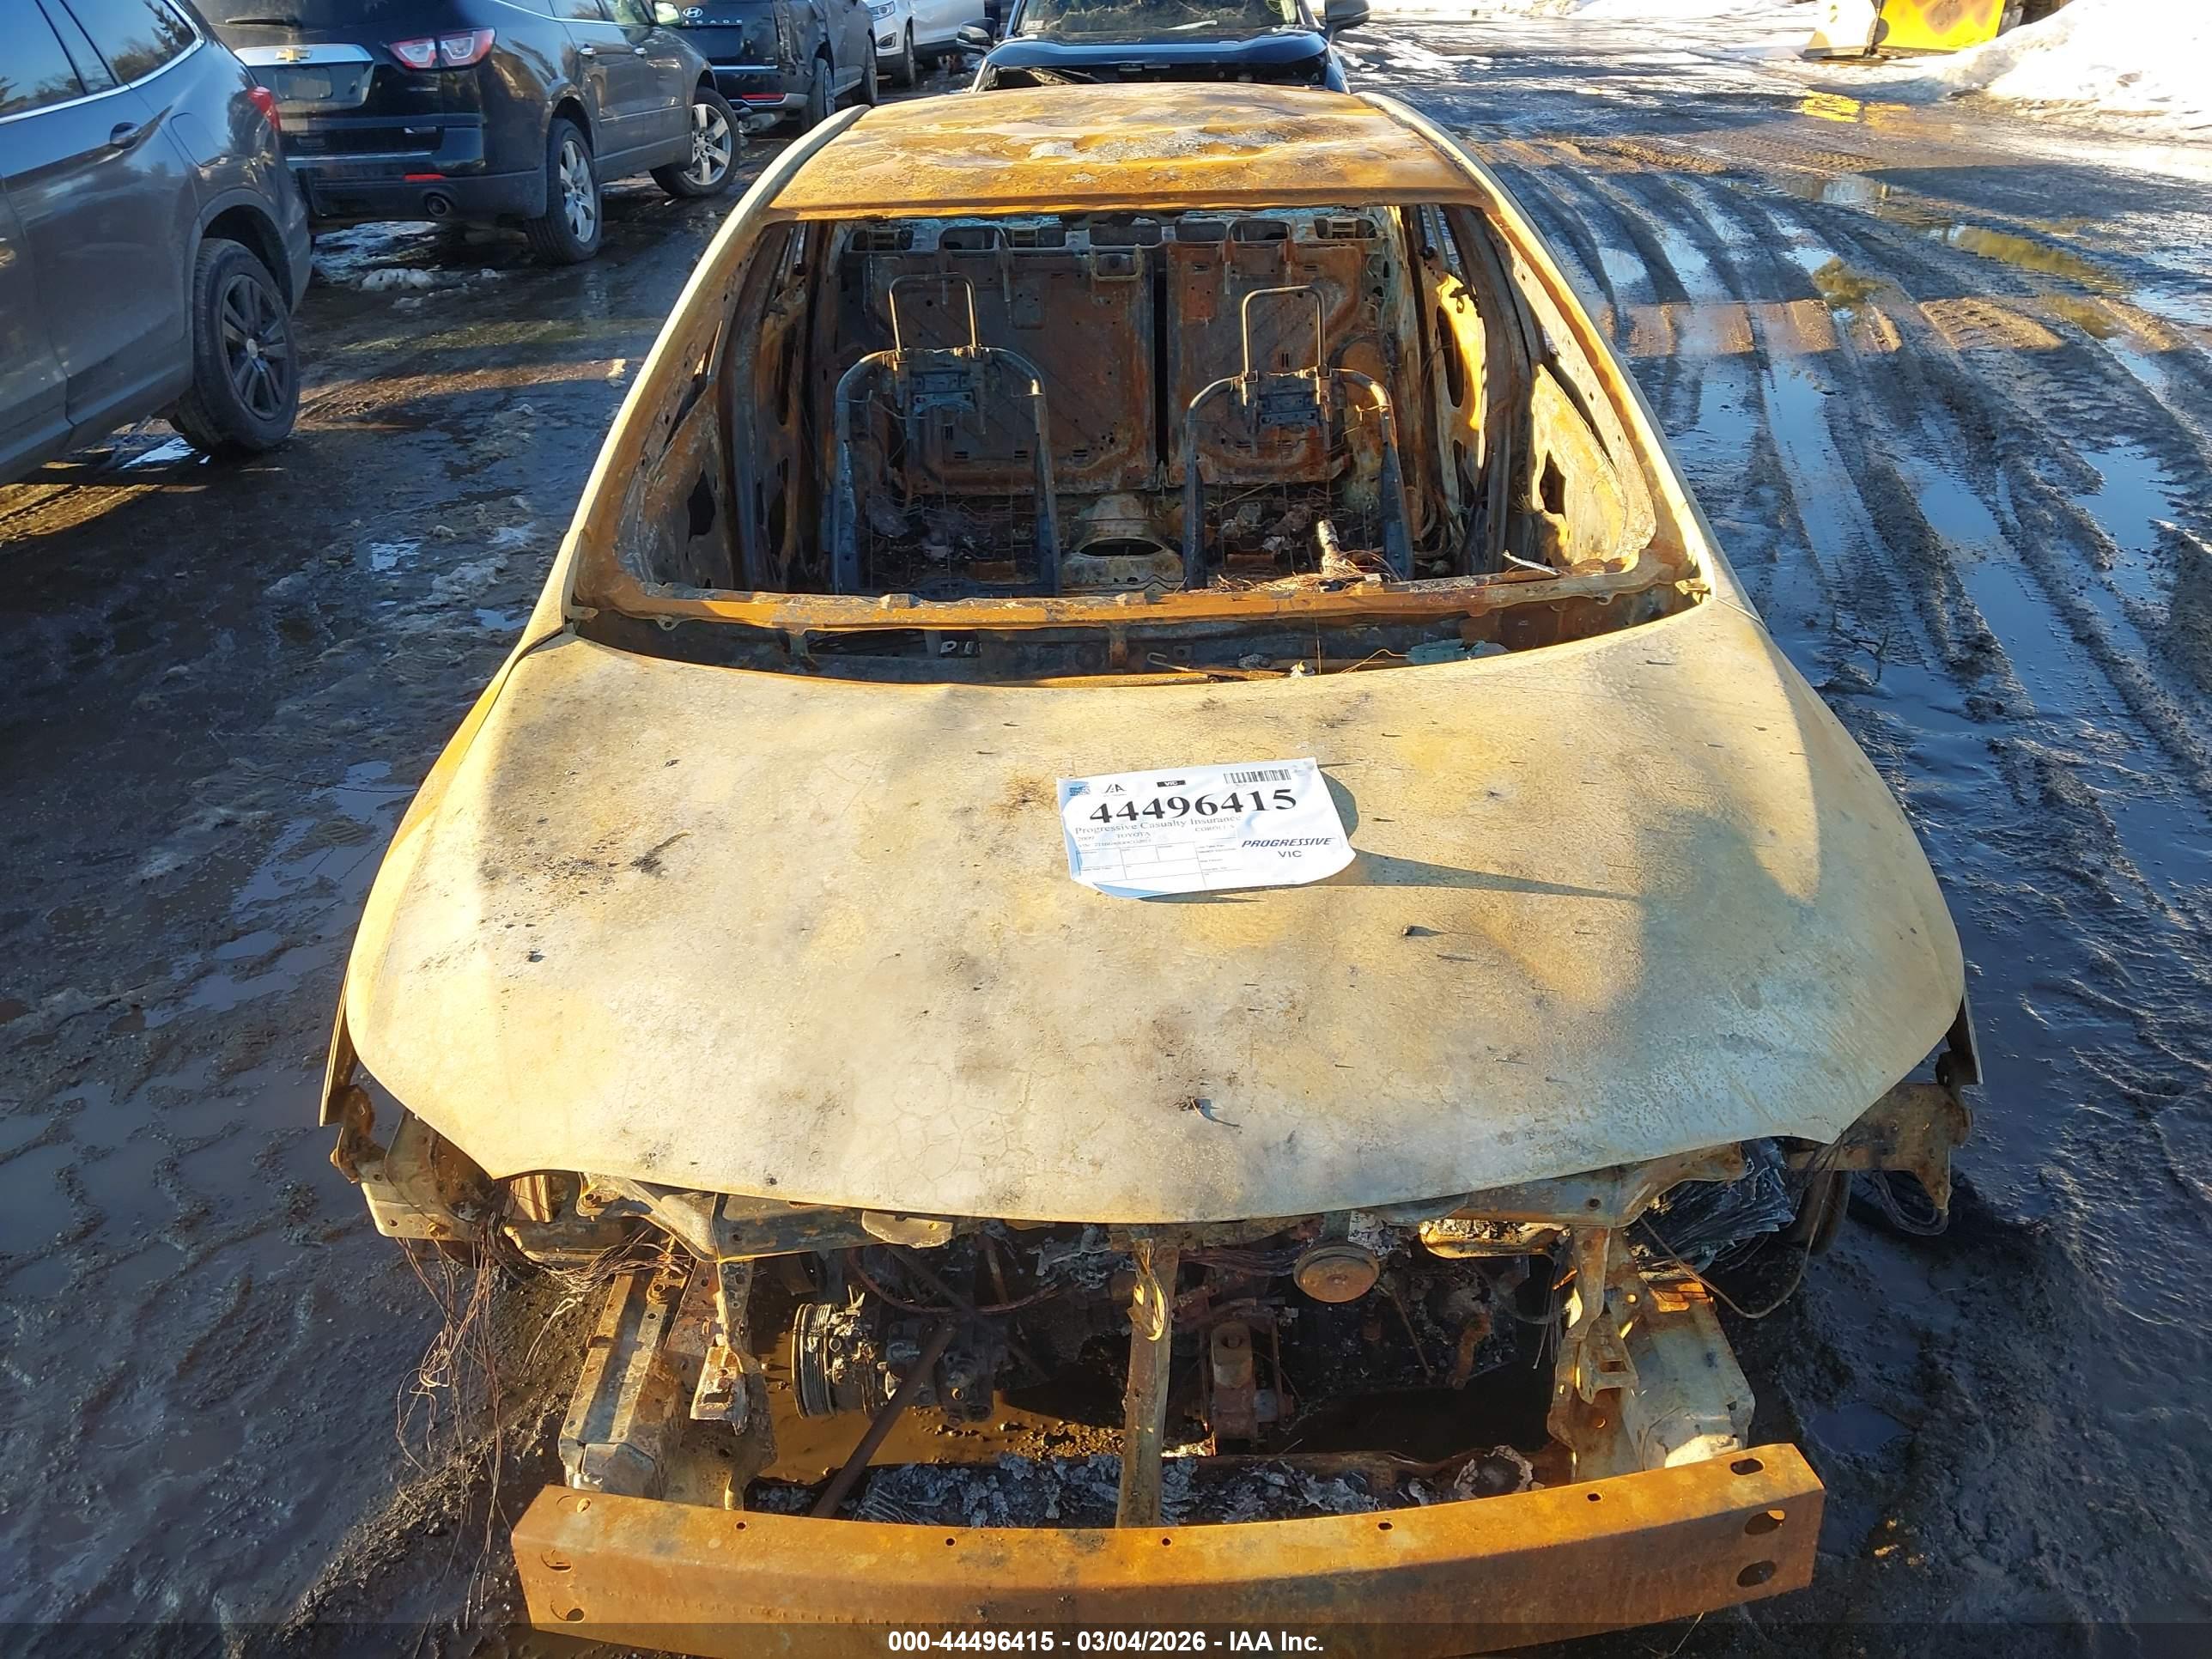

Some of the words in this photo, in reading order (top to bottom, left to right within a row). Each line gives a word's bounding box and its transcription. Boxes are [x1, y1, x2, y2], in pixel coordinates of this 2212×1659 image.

[1090, 789, 1297, 823] 44496415
[1075, 824, 1138, 834] Progressive
[1139, 819, 1187, 829] Casualty
[1190, 817, 1242, 825] Insurance
[1242, 837, 1333, 848] PROGRESSIVE
